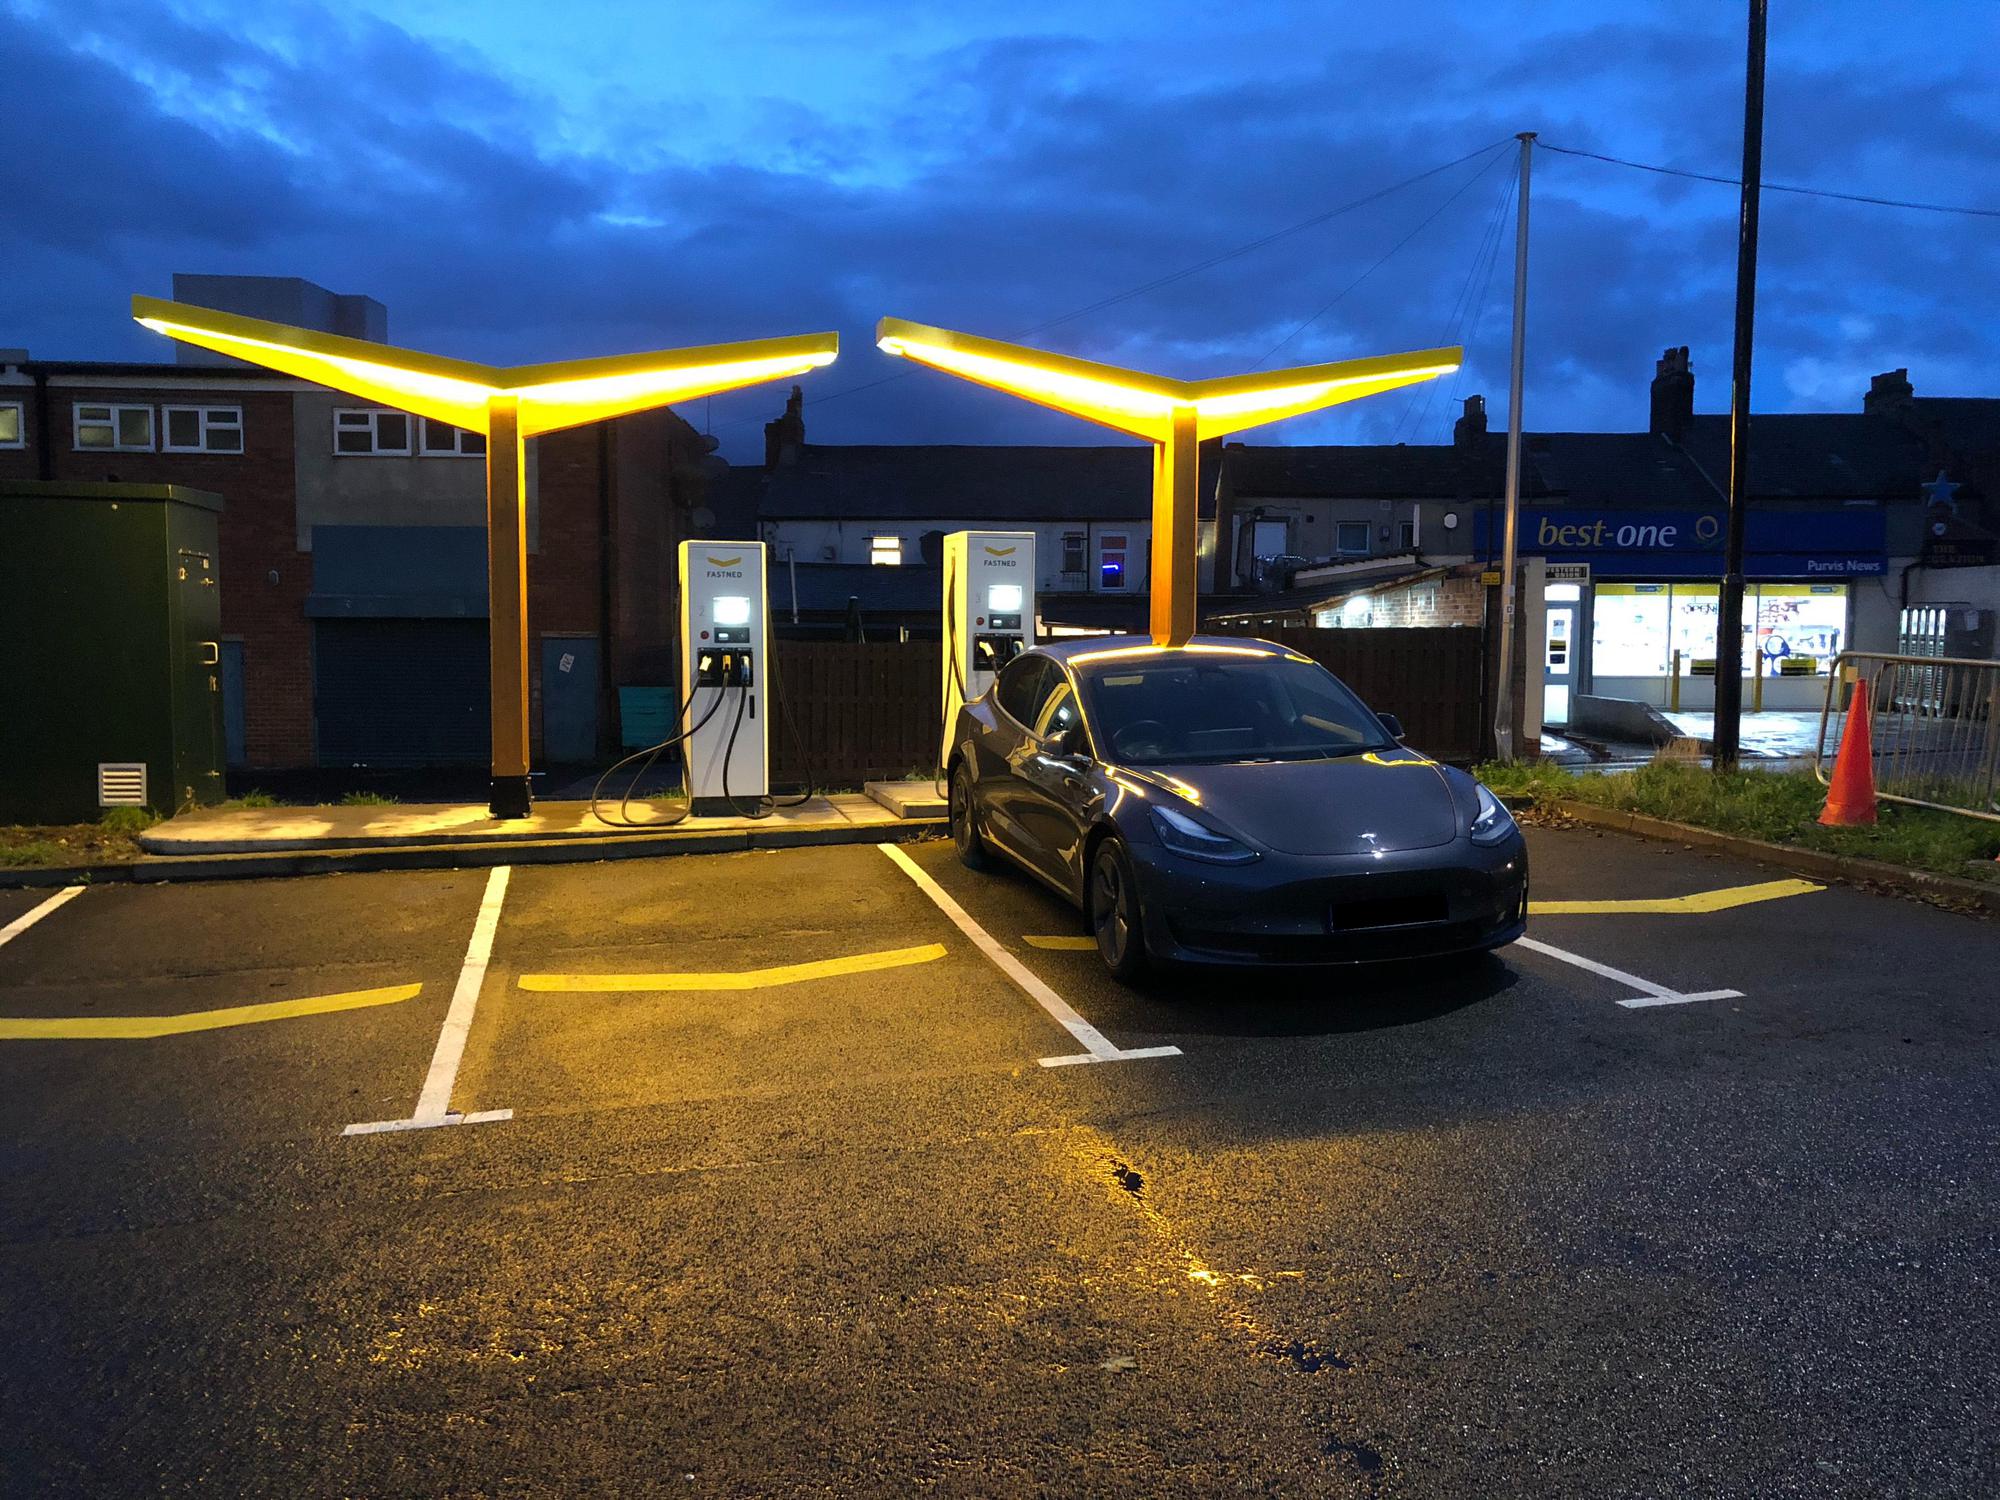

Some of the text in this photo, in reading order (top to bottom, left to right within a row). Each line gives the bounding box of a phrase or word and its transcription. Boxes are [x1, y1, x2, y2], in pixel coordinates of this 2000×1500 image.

[1538, 516, 1677, 547] best-one
[1807, 560, 1880, 571] Purvis News
